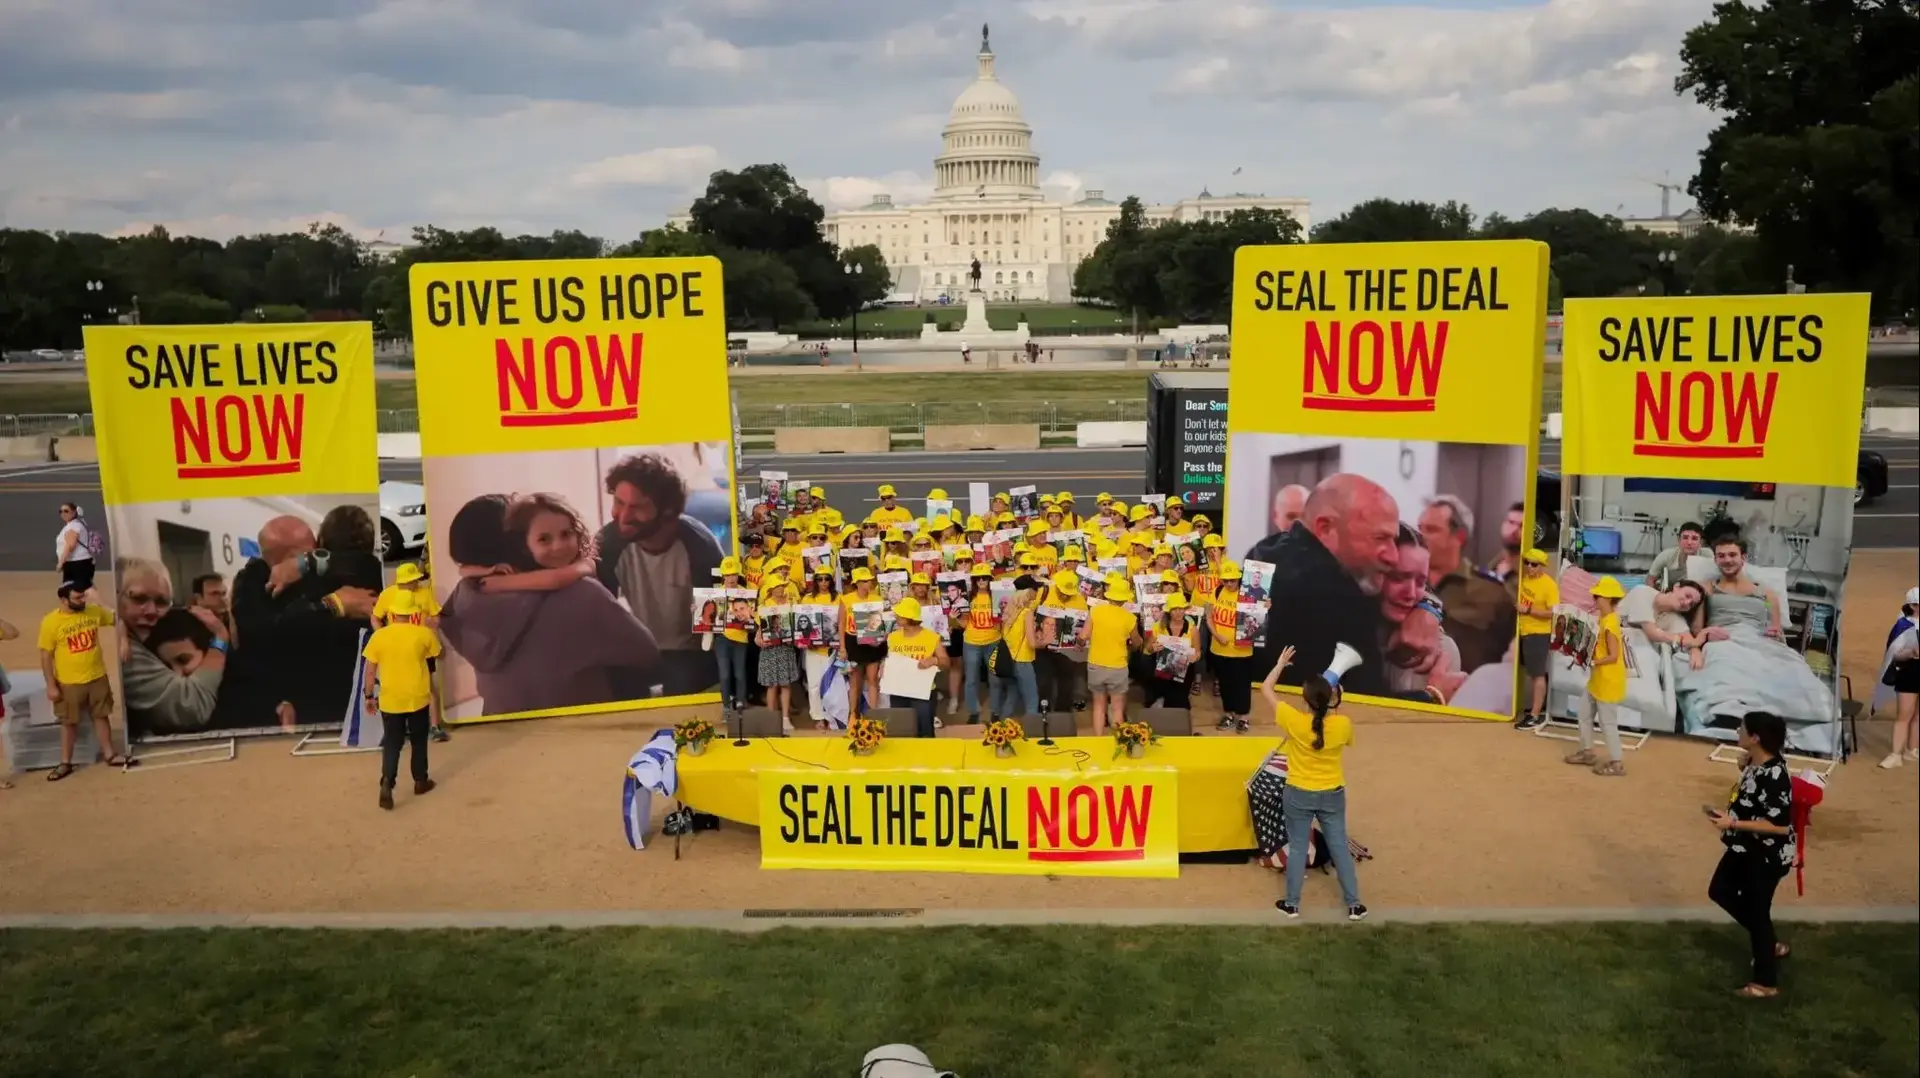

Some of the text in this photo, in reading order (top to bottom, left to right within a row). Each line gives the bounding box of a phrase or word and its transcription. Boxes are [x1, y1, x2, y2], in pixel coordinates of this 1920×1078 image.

[426, 271, 704, 327] GIVE US HOPE
[1254, 266, 1509, 312] SEAL THE DEAL
[1303, 320, 1449, 397] NOW
[1598, 314, 1824, 363] SAVE LIVES
[125, 340, 338, 390] SAVE LIVES
[495, 332, 644, 412] NOW
[170, 393, 304, 464] NOW
[1184, 419, 1206, 429] Don't
[1208, 419, 1219, 429] let
[1185, 400, 1207, 411] Dear
[1634, 370, 1779, 445] NOW
[1183, 443, 1227, 454] anyone els
[1184, 431, 1227, 441] to our kids
[1183, 461, 1223, 472] Pass the
[1183, 474, 1213, 484] Online
[222, 533, 234, 565] 6
[67, 627, 98, 649] NOW
[779, 785, 1153, 850] SEAL THE DEAL NOW
